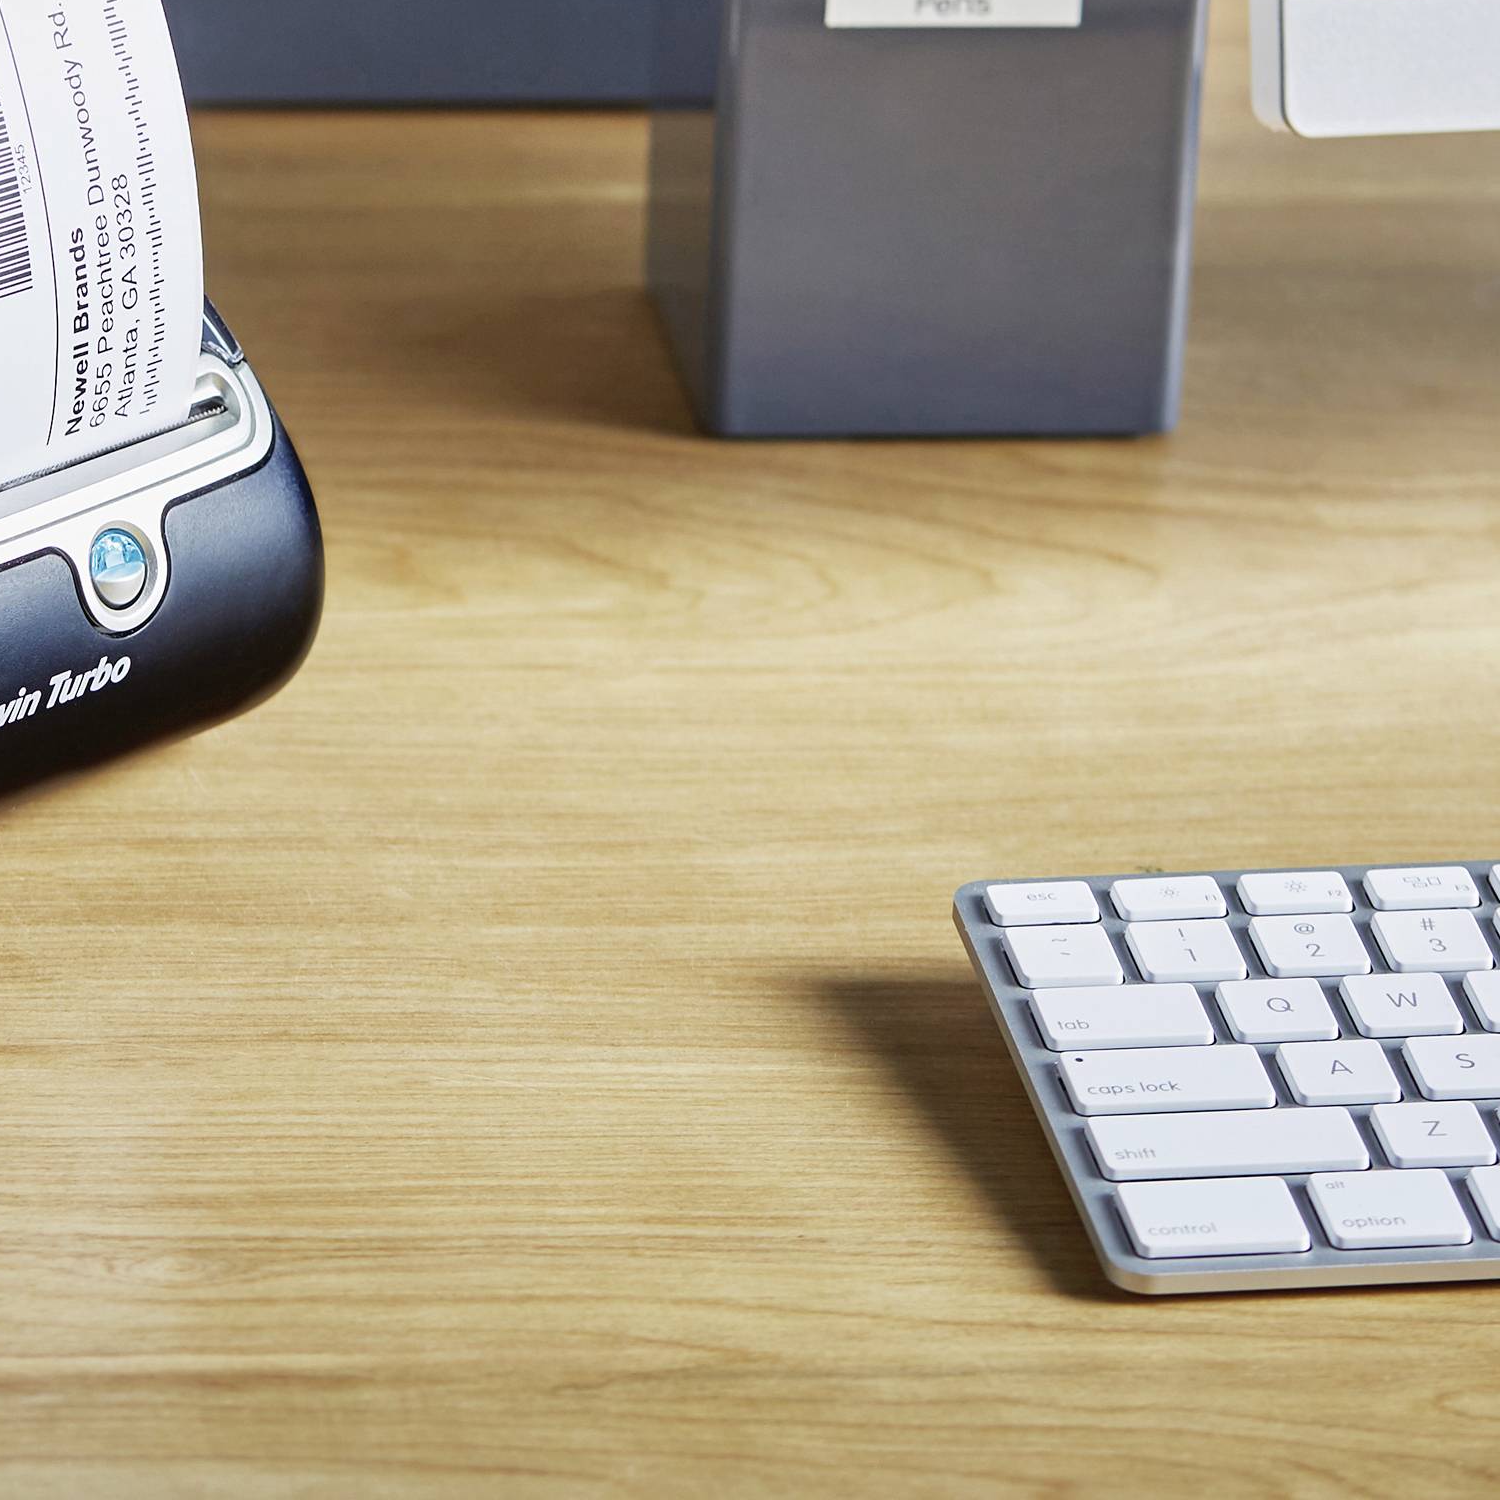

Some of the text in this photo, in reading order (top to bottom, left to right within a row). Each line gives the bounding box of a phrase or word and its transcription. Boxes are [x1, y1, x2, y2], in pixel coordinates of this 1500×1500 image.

[14, 143, 33, 194] 12345
[48, 2, 114, 428] 6655 Peachtree Dunwoody Rd.
[111, 173, 141, 417] Atlanta, GA 30328
[64, 227, 89, 436] Newell Brands
[47, 654, 131, 707] Turbo
[1026, 891, 1057, 902] esc
[1293, 922, 1315, 935] @
[1419, 917, 1436, 931] #
[1305, 943, 1325, 958] 2
[1429, 938, 1447, 952] 3
[1183, 947, 1197, 962] 1
[1267, 997, 1294, 1013] Q
[1386, 992, 1418, 1008] W
[1057, 1019, 1090, 1031] tab
[1331, 1059, 1354, 1075] A
[1455, 1053, 1475, 1069] S
[1087, 1080, 1181, 1097] caps lock
[1421, 1120, 1448, 1137] Z
[1114, 1147, 1157, 1161] shift
[1325, 1180, 1345, 1190] alt
[1147, 1221, 1218, 1237] control
[1341, 1215, 1406, 1230] option
